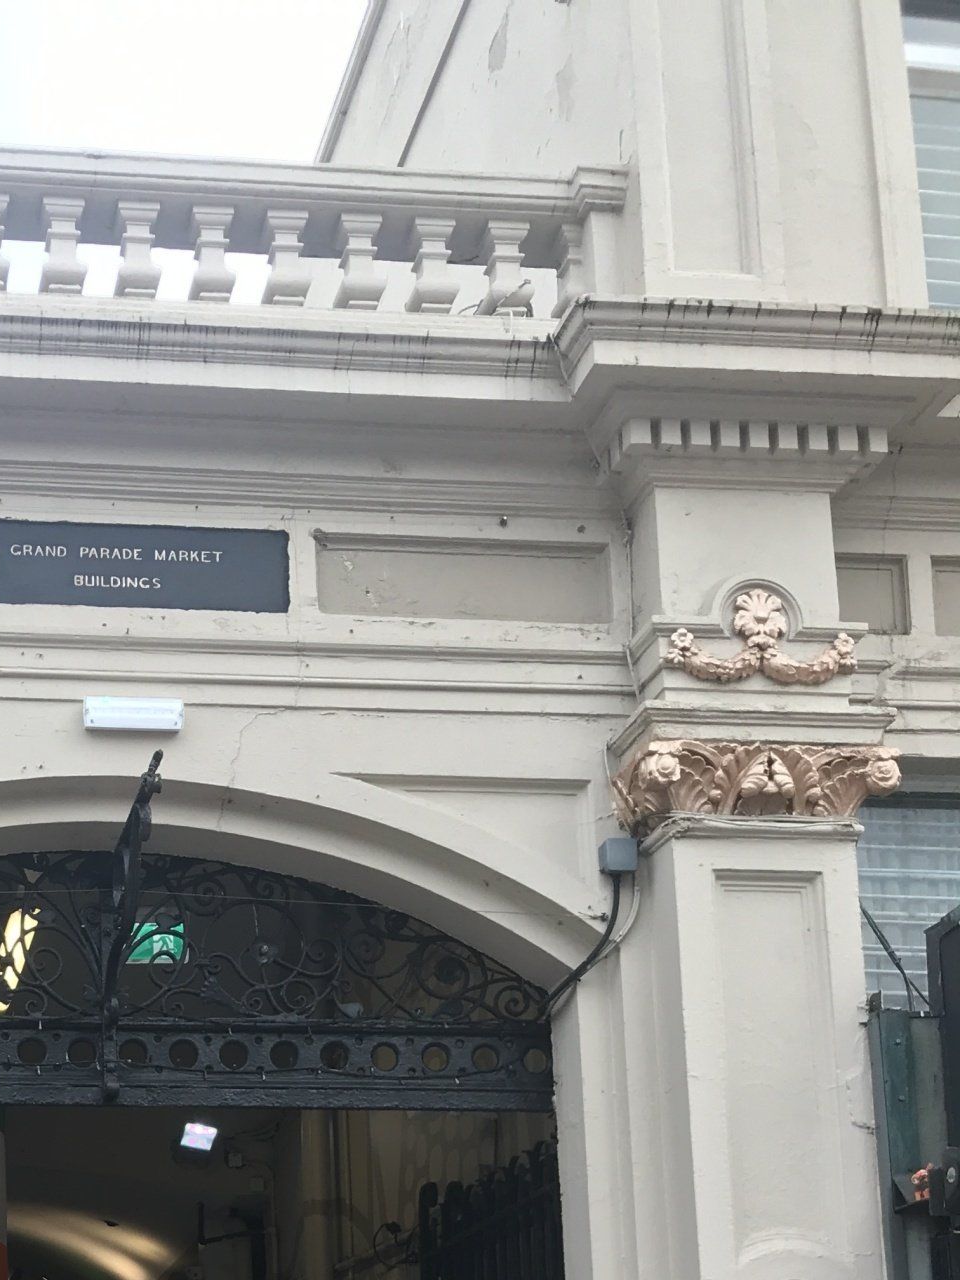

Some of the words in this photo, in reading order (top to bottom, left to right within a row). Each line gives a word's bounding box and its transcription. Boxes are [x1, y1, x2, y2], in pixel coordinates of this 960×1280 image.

[10, 544, 67, 558] GRAND
[79, 547, 143, 561] PARADE
[154, 550, 223, 563] MARKET
[73, 575, 161, 589] BUILDINGS
